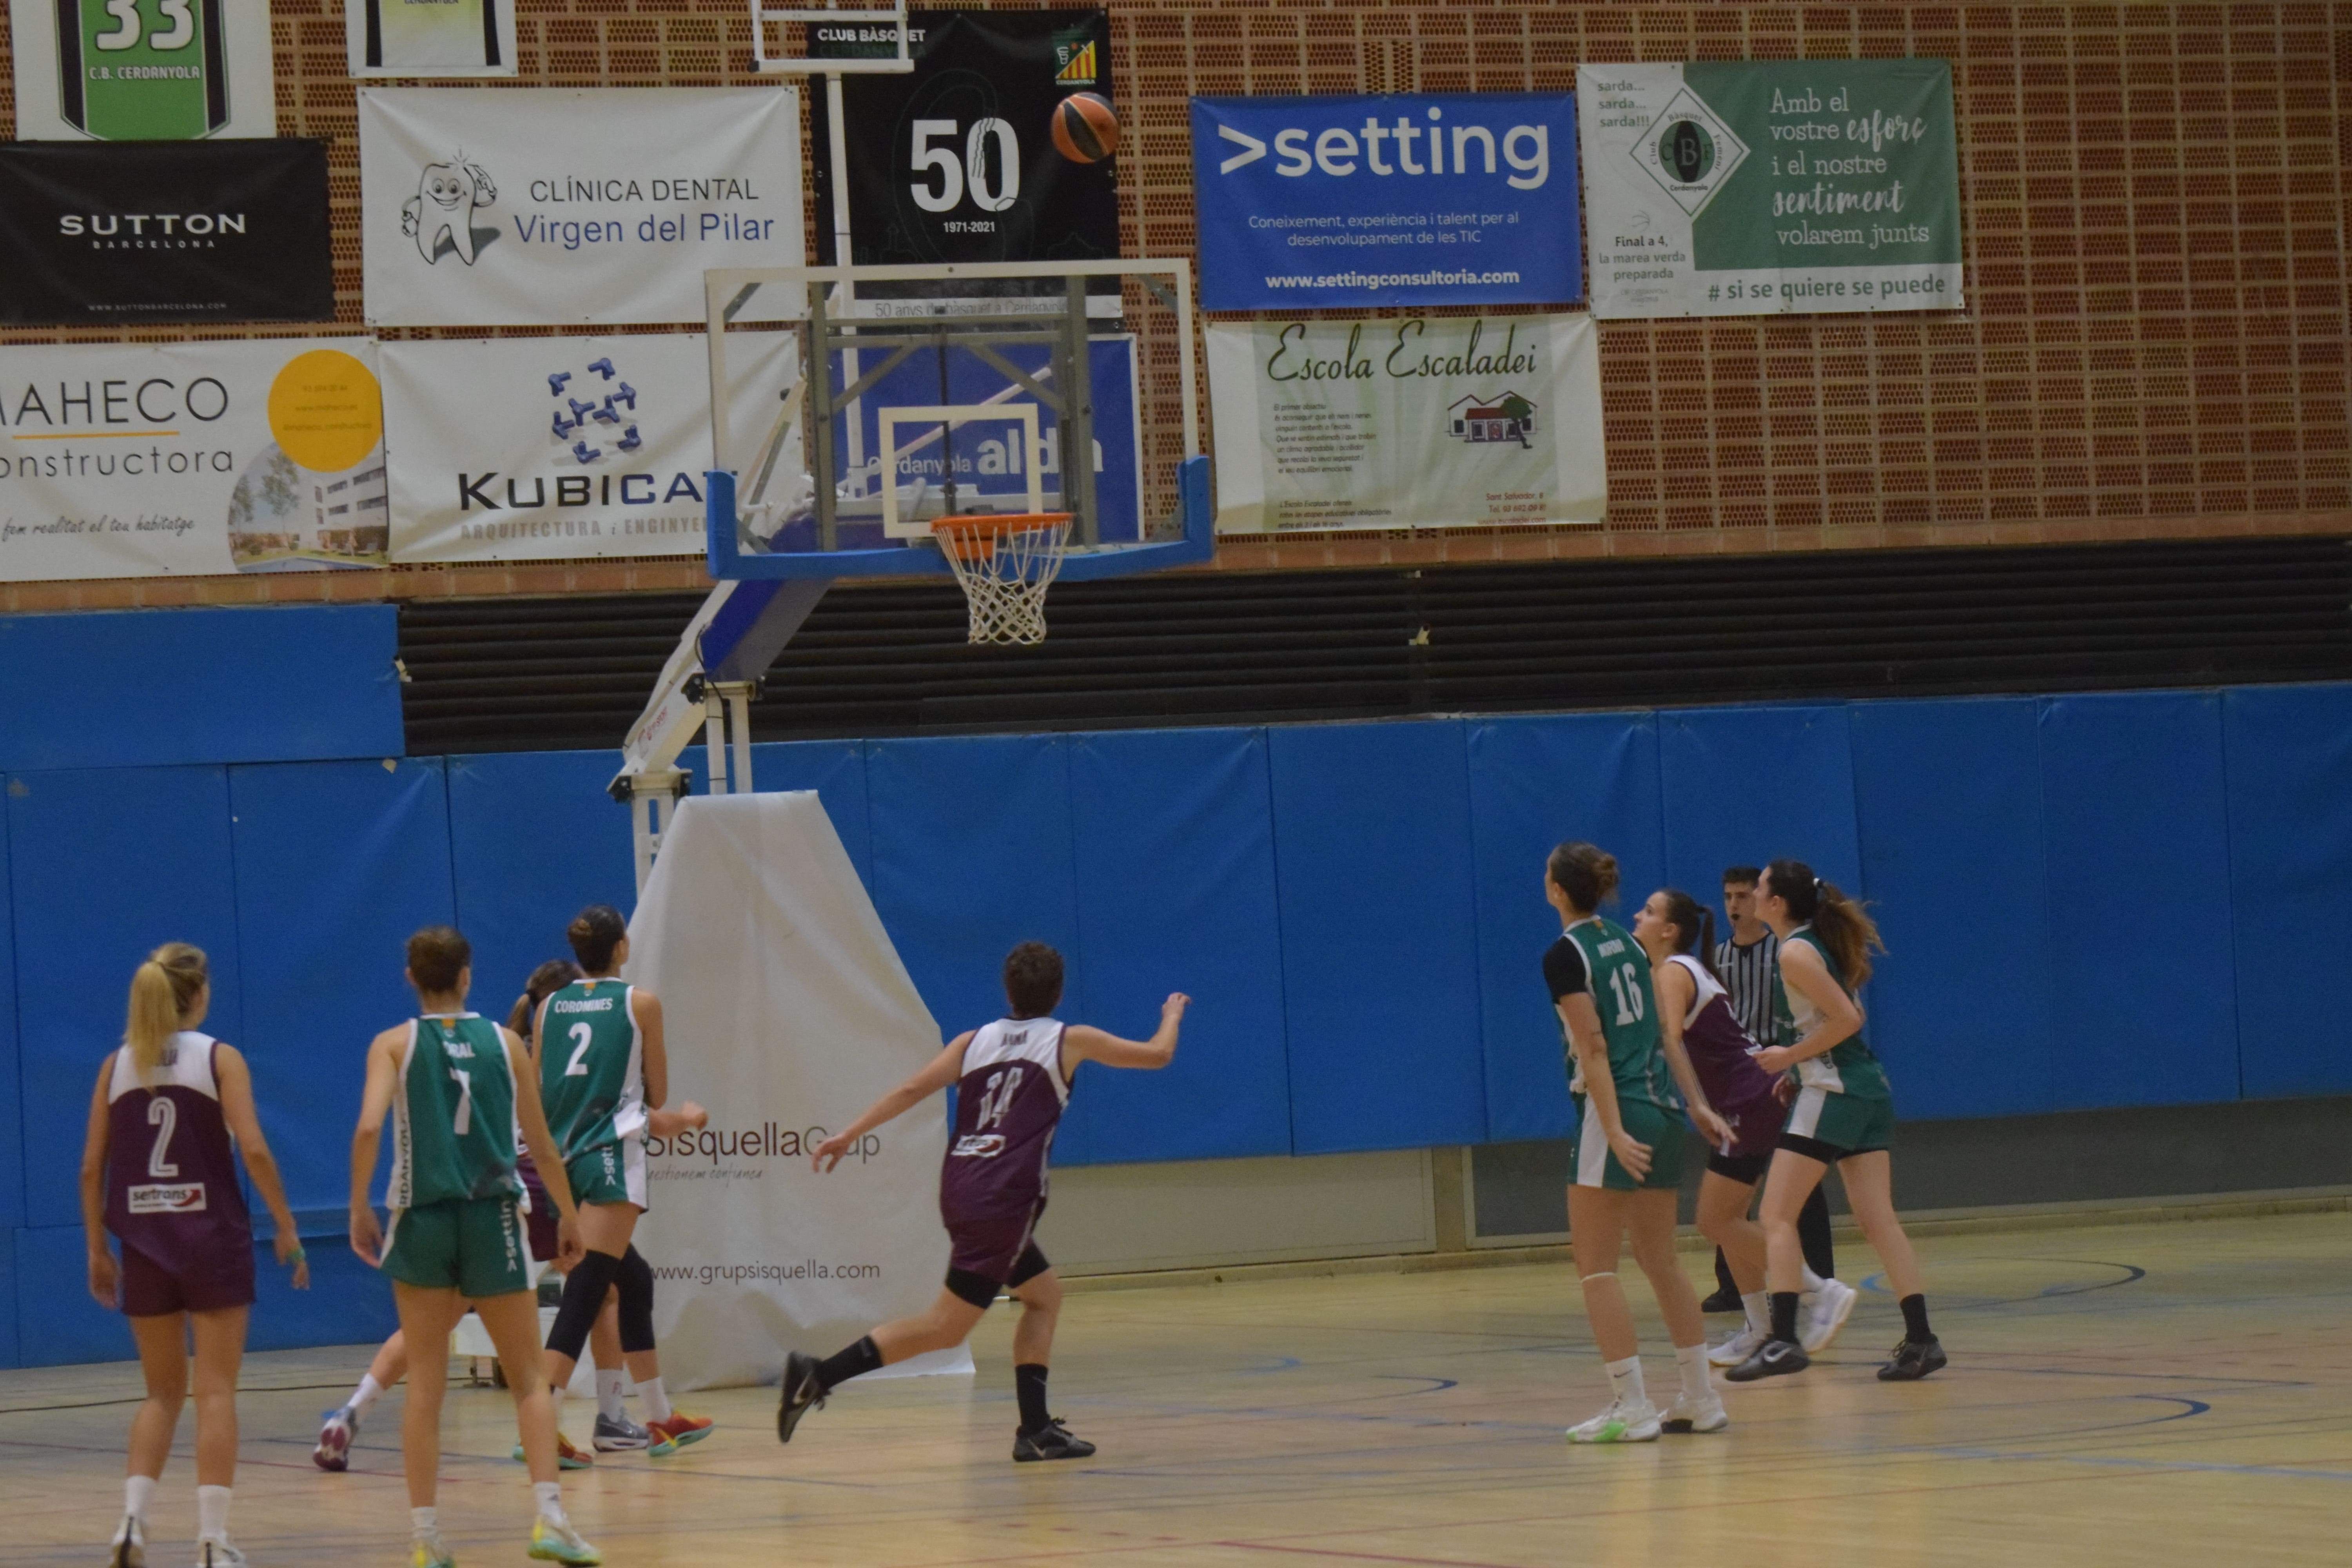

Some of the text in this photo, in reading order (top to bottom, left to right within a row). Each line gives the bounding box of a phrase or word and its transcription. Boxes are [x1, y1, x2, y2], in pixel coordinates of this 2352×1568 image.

[817, 25, 926, 42] CLUB BÀSQET
[89, 65, 201, 80] C.B. CERDANYOLA
[1597, 80, 1644, 91] sarda...
[1599, 98, 1646, 109] sarda...
[1769, 87, 1849, 114] Amb el
[1600, 116, 1649, 127] sarda!!!
[1769, 109, 1928, 152] vostre esforç
[910, 118, 1019, 212] 50
[1772, 151, 1887, 175] i el nostre
[530, 175, 759, 202] CLÍNICA DENTAL
[1773, 180, 1905, 216] sentiment
[59, 213, 247, 235] SUTTON
[514, 212, 774, 251] Virgen del Pilar
[943, 221, 995, 233] 1971-2021
[1249, 212, 1519, 229] Coneixement, experiència i talent per al
[91, 239, 216, 250] BARCELONA
[1287, 230, 1481, 247] desenvolupament de les TIC
[1615, 236, 1645, 247] Final
[1776, 220, 1930, 250] volarem junts
[1599, 251, 1685, 263] la marea verda
[1265, 268, 1519, 289] www.settingconsultoria.com
[1614, 268, 1673, 282] preparada
[1728, 279, 1743, 299] si
[1750, 283, 1773, 298] se
[1780, 277, 1846, 302] quiere
[1852, 281, 1874, 295] se
[1881, 274, 1945, 300] puede
[875, 303, 891, 317] 50
[1267, 319, 1537, 381] Escola Escaladei
[0, 377, 229, 425] AHECO
[457, 470, 739, 510] KUBICA
[32, 515, 85, 534] realitat
[89, 514, 108, 532] el
[135, 514, 195, 537] habitatge
[460, 520, 601, 541] ARQUITECTURA
[612, 523, 617, 536] i
[1609, 962, 1644, 1026] 16
[554, 998, 613, 1013] COROMINES
[565, 1022, 592, 1076] 2
[148, 1097, 179, 1178] 2
[650, 1259, 880, 1285] www.grupsisquella.com
